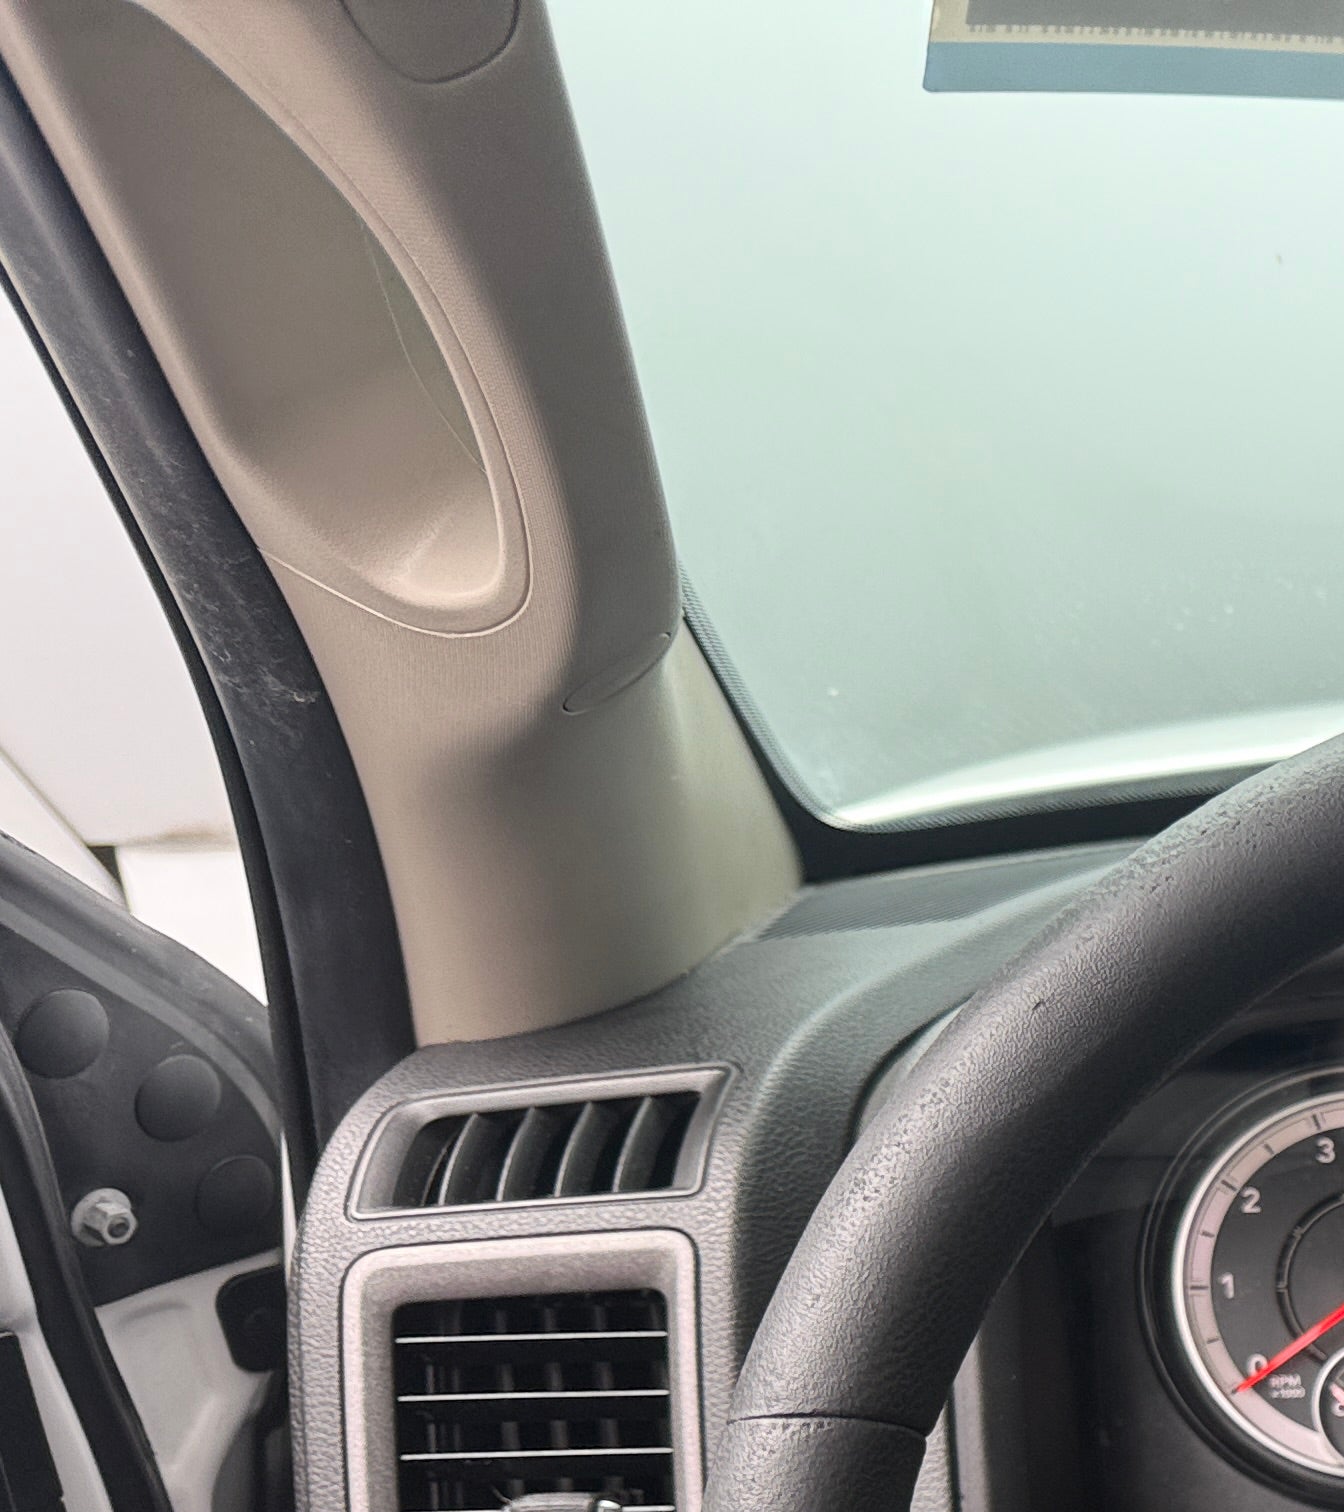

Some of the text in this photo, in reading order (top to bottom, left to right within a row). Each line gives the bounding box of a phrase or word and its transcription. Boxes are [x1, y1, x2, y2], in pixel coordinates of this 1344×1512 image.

[1316, 1138, 1336, 1164] 3
[1241, 1188, 1262, 1213] 2
[1219, 1274, 1235, 1298] 1
[1268, 1374, 1301, 1388] RPM
